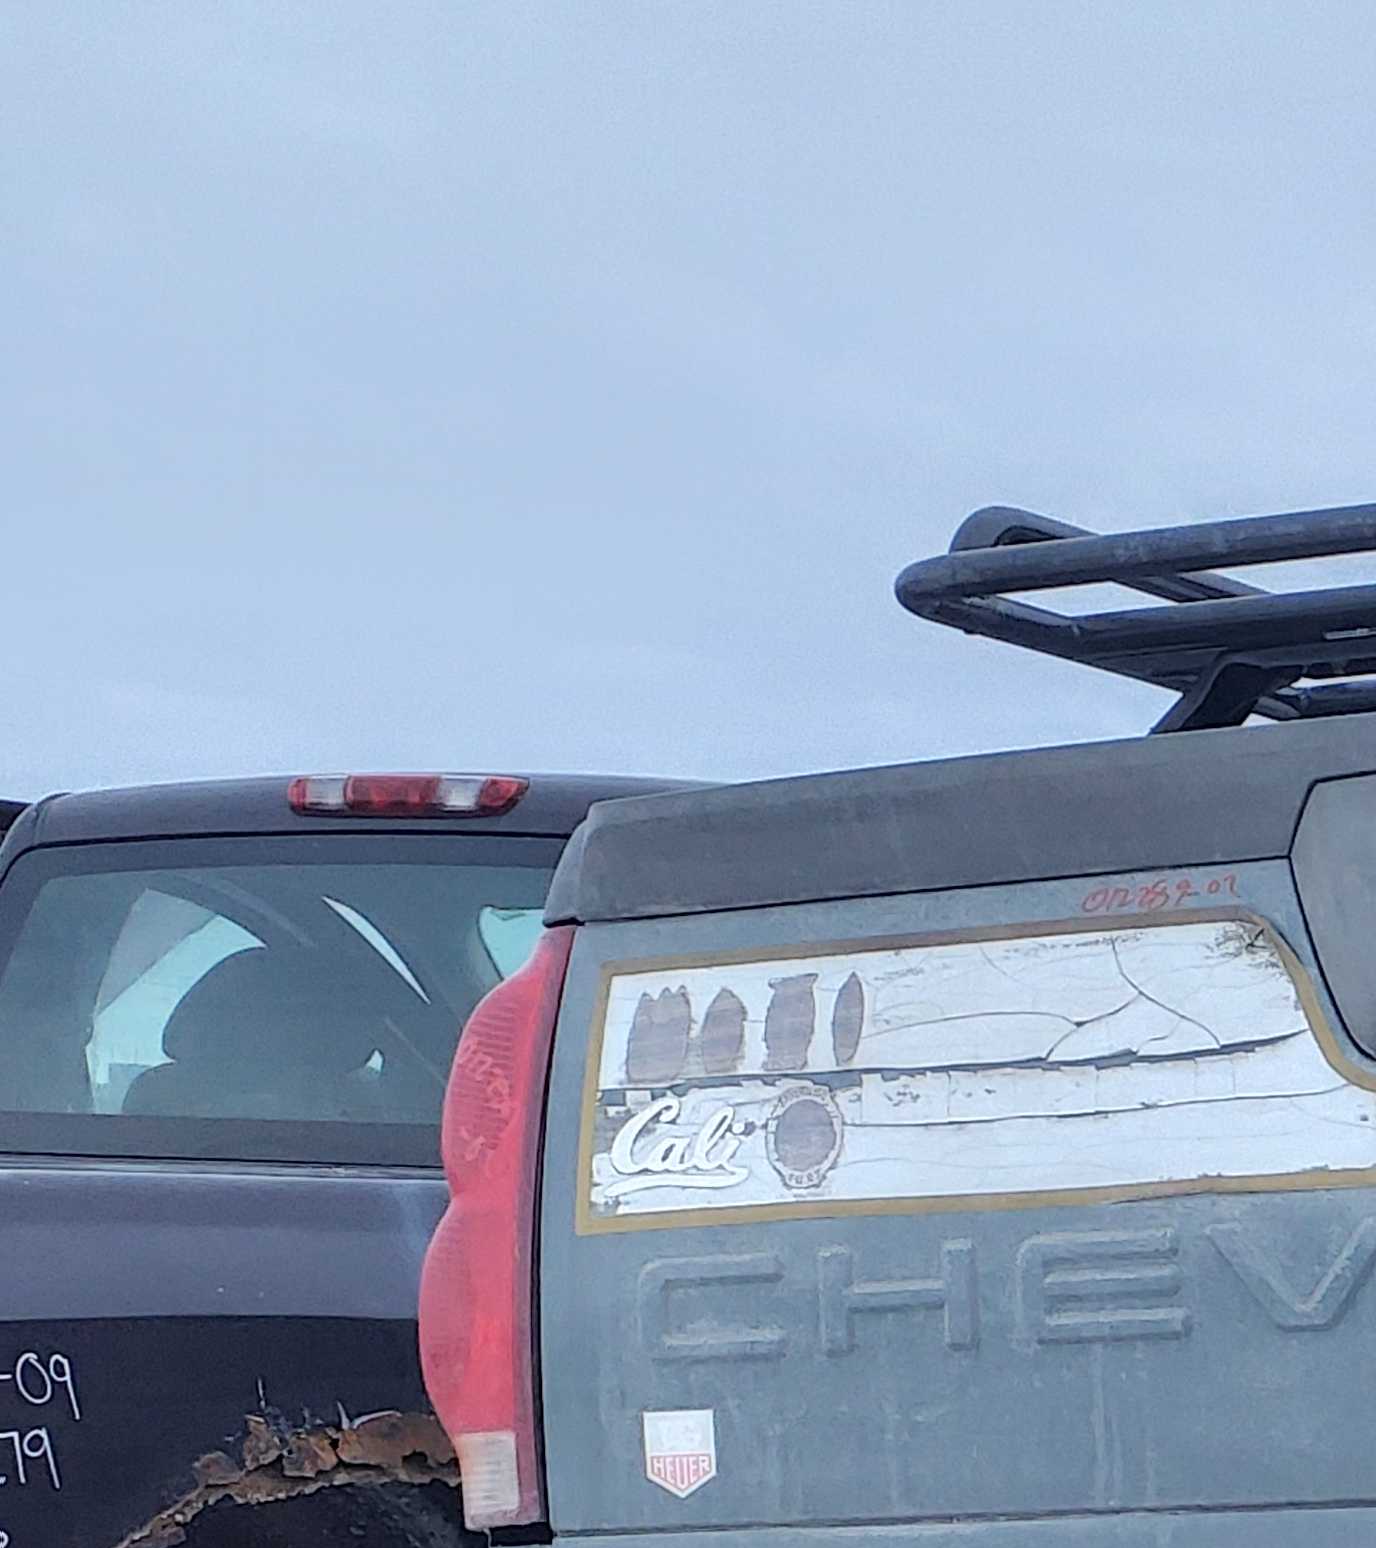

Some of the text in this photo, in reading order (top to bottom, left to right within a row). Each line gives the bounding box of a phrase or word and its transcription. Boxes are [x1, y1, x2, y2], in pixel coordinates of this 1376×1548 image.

[606, 1098, 749, 1190] Cali
[0, 1426, 61, 1489] 79
[652, 1455, 711, 1489] HEUER
